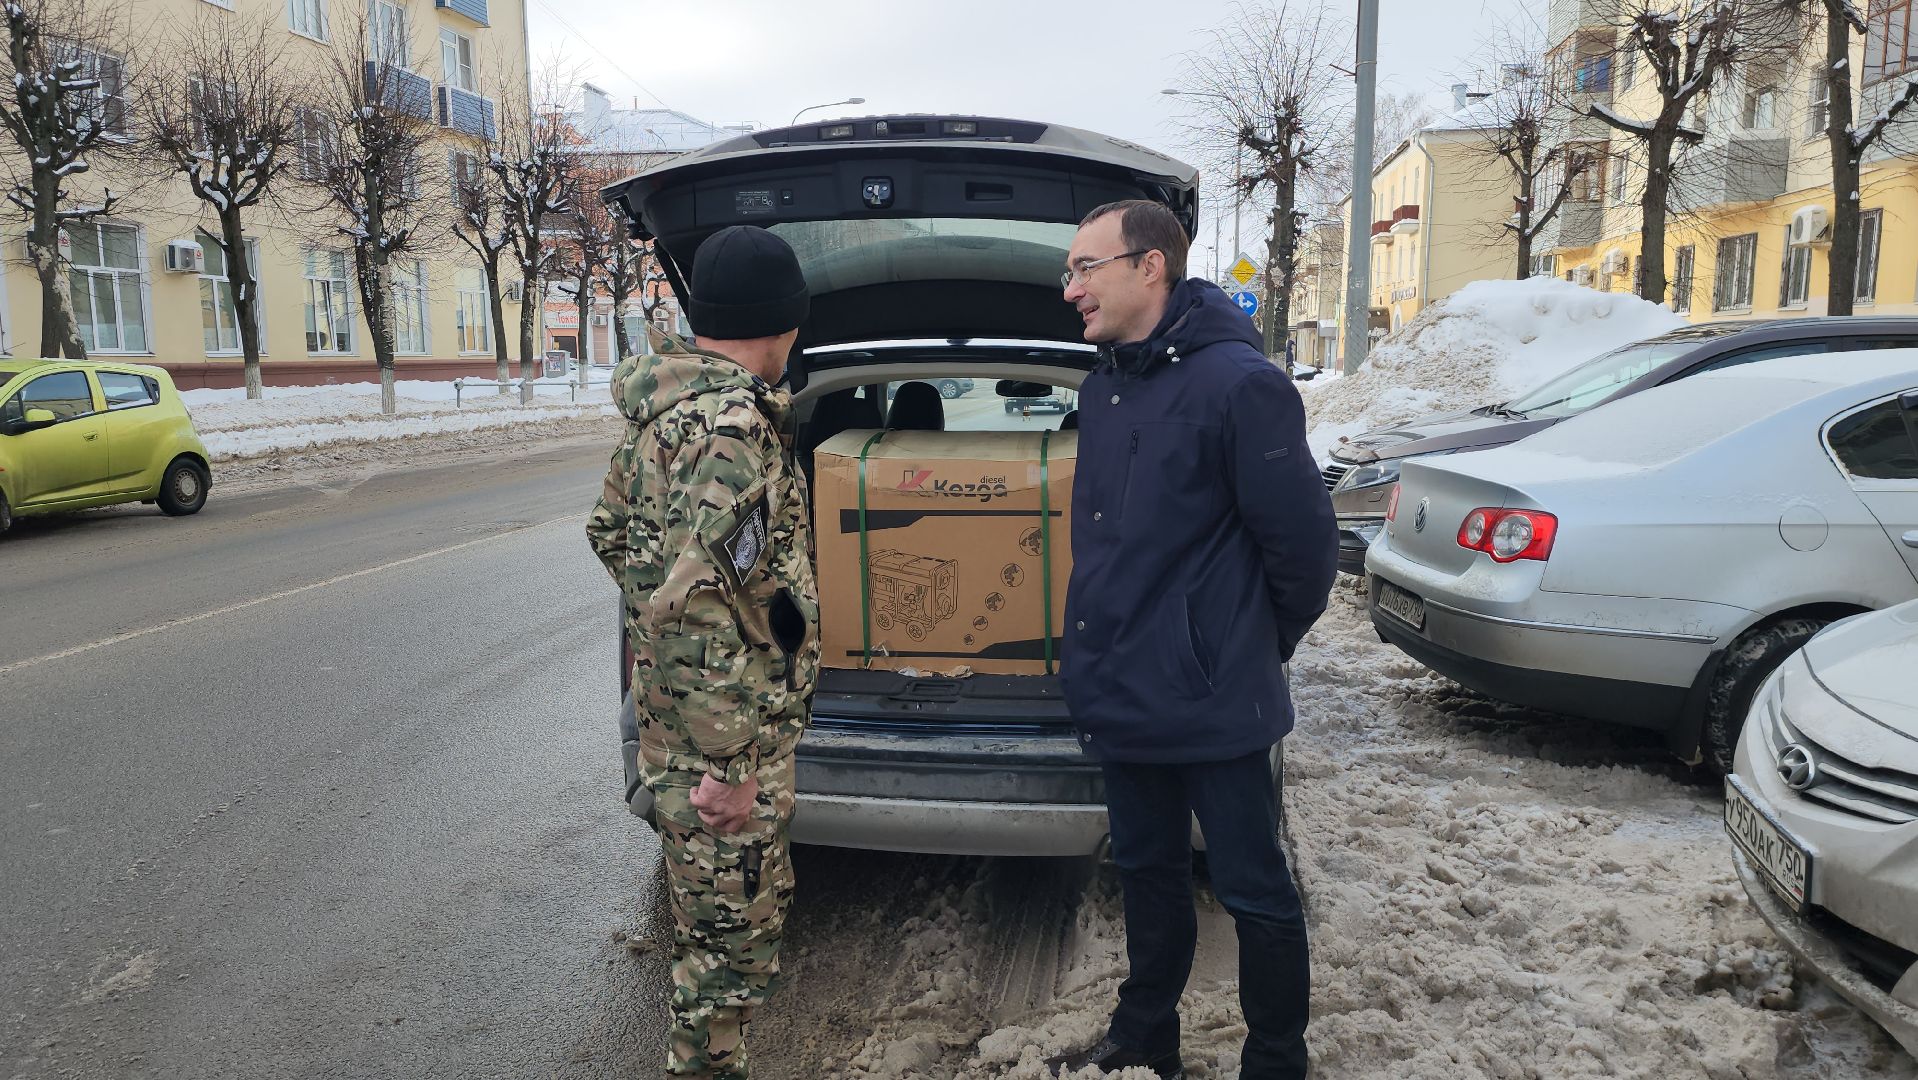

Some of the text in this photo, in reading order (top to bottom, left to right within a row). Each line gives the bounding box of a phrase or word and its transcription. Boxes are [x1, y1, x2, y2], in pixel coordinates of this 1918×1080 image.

[980, 475, 1006, 484] diesel
[1728, 796, 1801, 880] У950АК 750
